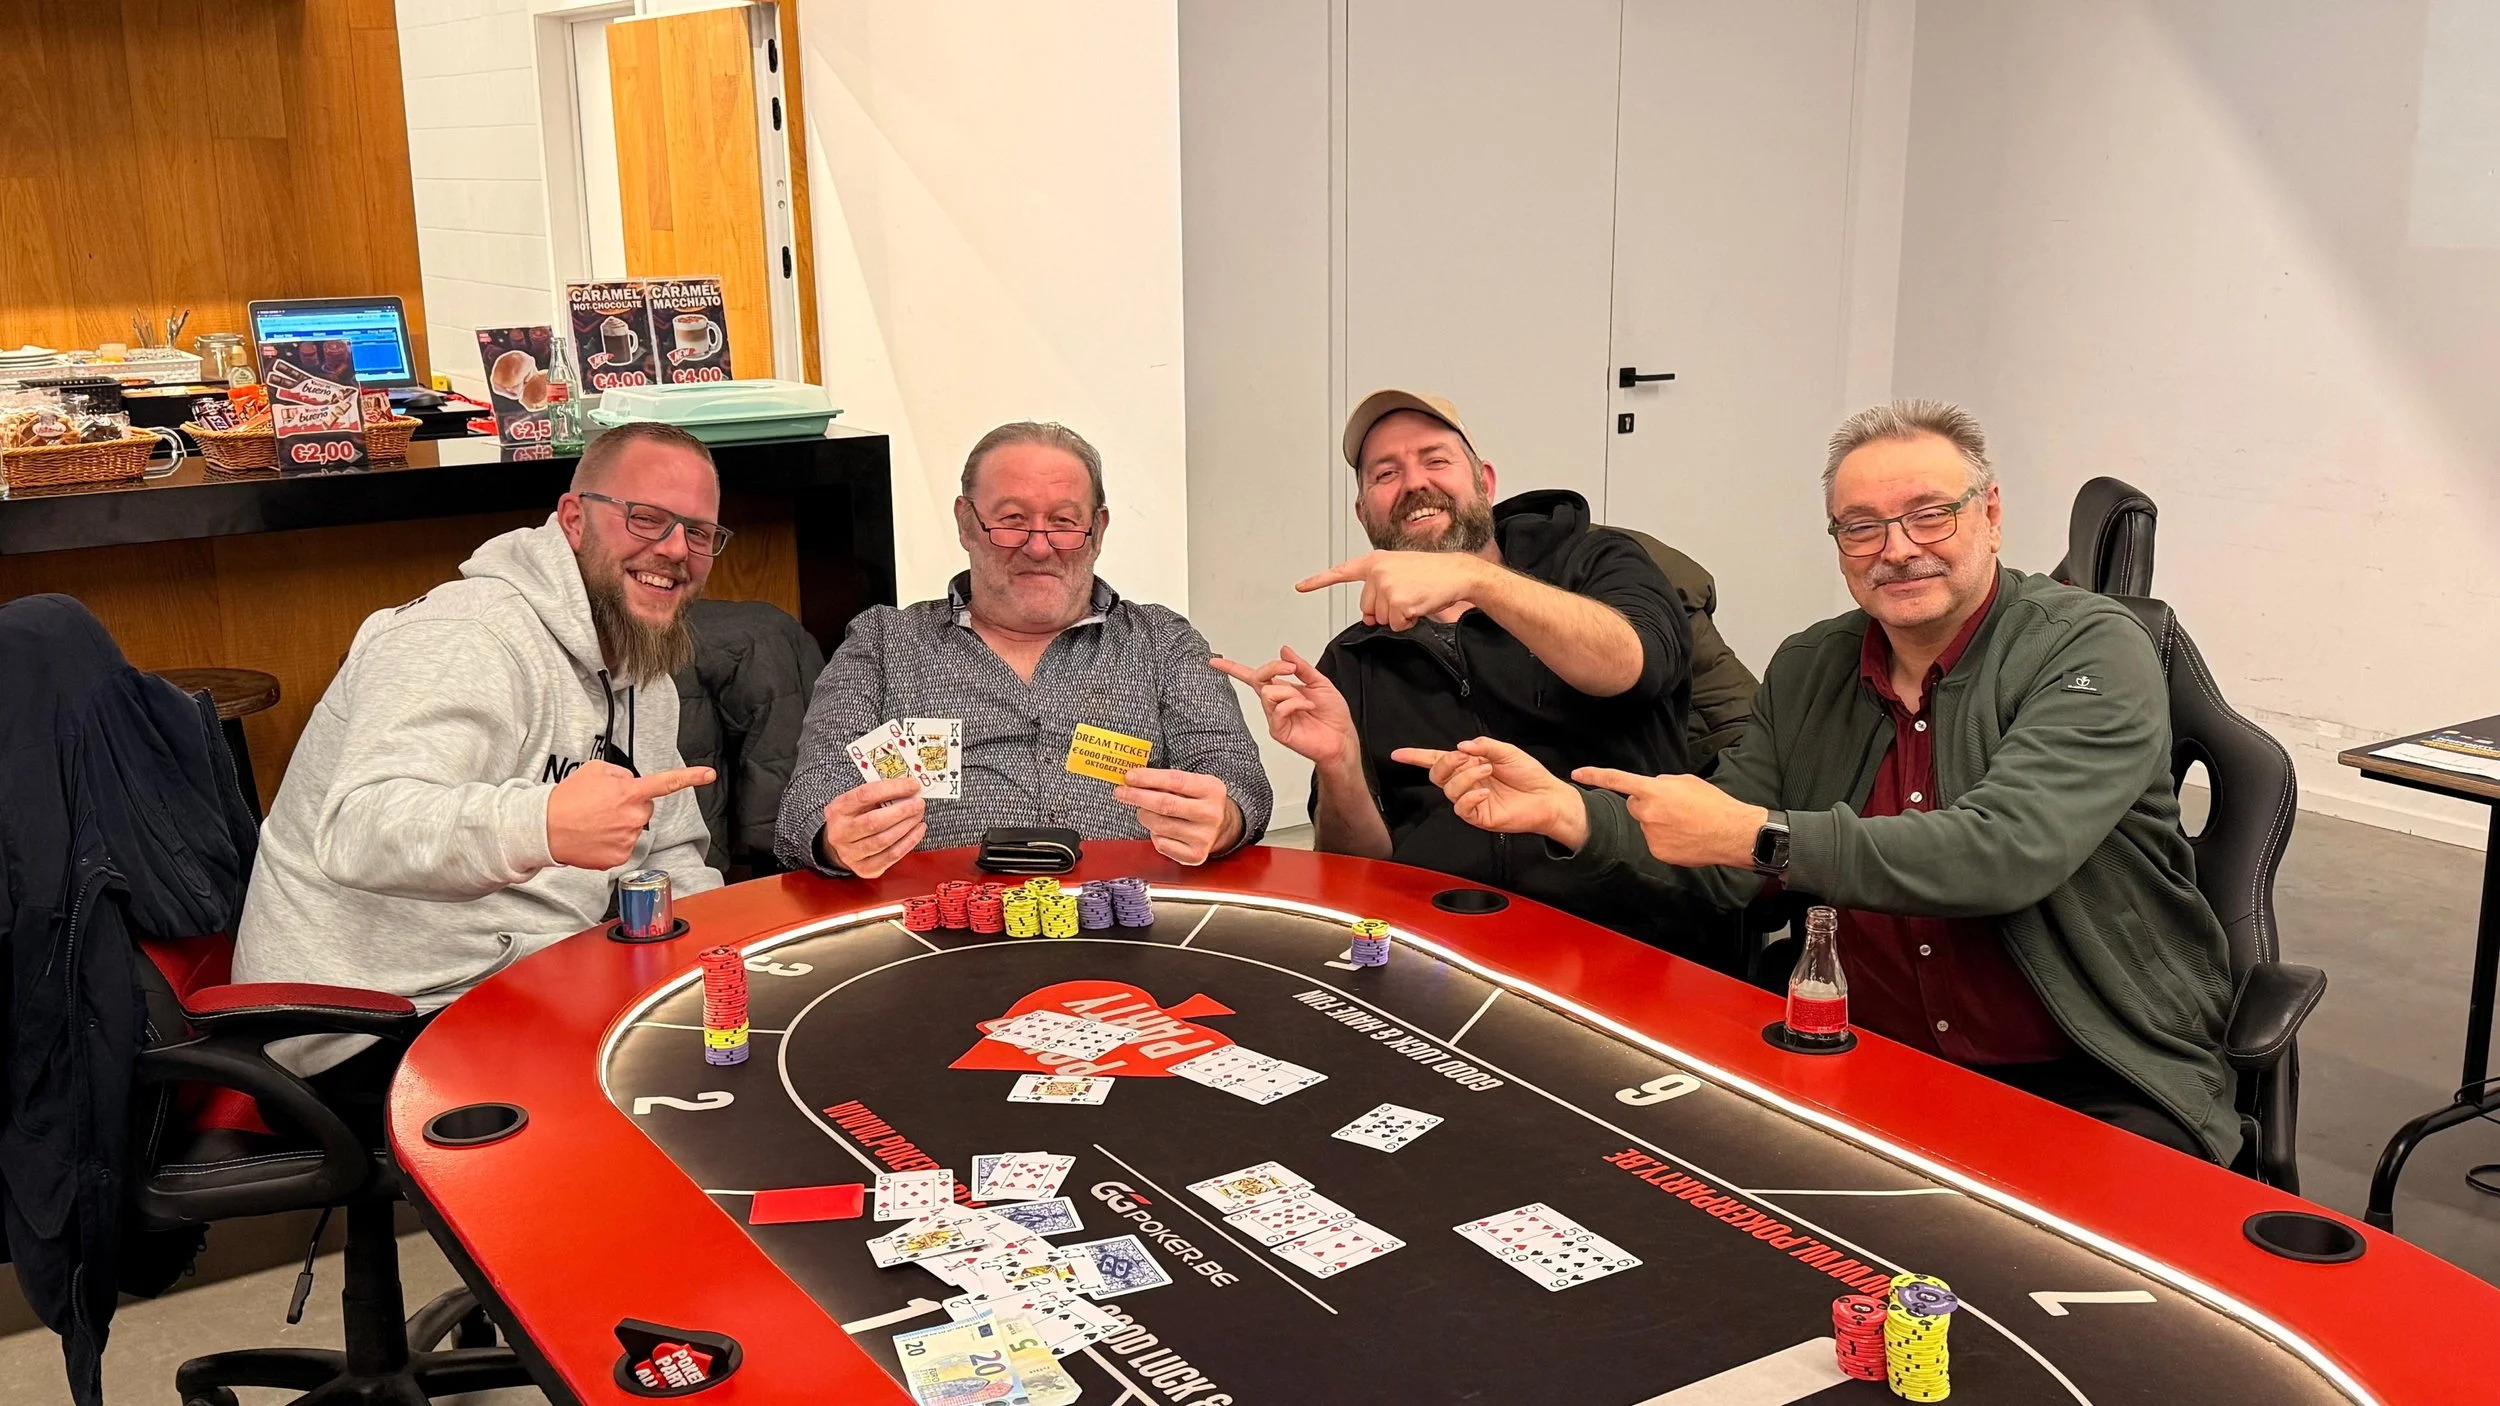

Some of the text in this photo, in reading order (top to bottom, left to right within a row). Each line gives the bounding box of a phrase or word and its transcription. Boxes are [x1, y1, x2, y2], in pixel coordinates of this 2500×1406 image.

[571, 288, 641, 302] CARAMEL
[652, 285, 719, 299] CARAMEL
[573, 300, 643, 311] HOT CHOCOLATE
[653, 296, 721, 310] MACCHIATO
[511, 420, 551, 440] €2,5
[291, 441, 354, 465] €2,00
[889, 723, 902, 738] Q
[906, 722, 915, 737] K
[950, 723, 960, 737] K
[1074, 731, 1150, 758] DREAM TICKET
[851, 745, 864, 760] Q
[1085, 759, 1118, 773] OKTOBER
[918, 773, 931, 787] Q
[949, 780, 958, 795] K
[743, 955, 814, 977] 3
[1292, 989, 1347, 1011] FUN
[1324, 1006, 1390, 1033] HAVE
[1382, 1035, 1452, 1065] LUCK
[1431, 1060, 1504, 1092] GOOD
[632, 1090, 735, 1115] 2
[1005, 1155, 1017, 1163] 7
[1060, 1157, 1073, 1166] 7
[879, 1175, 892, 1185] 5
[938, 1171, 950, 1180] 5
[878, 1209, 890, 1218] 5
[1015, 1235, 1037, 1246] K
[944, 1260, 966, 1272] K
[1030, 1277, 1051, 1288] 2
[950, 1298, 972, 1309] 2
[841, 1297, 944, 1335] 1
[1101, 1323, 1119, 1334] 4
[905, 1340, 926, 1357] 20
[1009, 1338, 1039, 1353] 5
[969, 1349, 1007, 1377] 20
[655, 1355, 688, 1388] PART
[1127, 1347, 1218, 1403] LUCK
